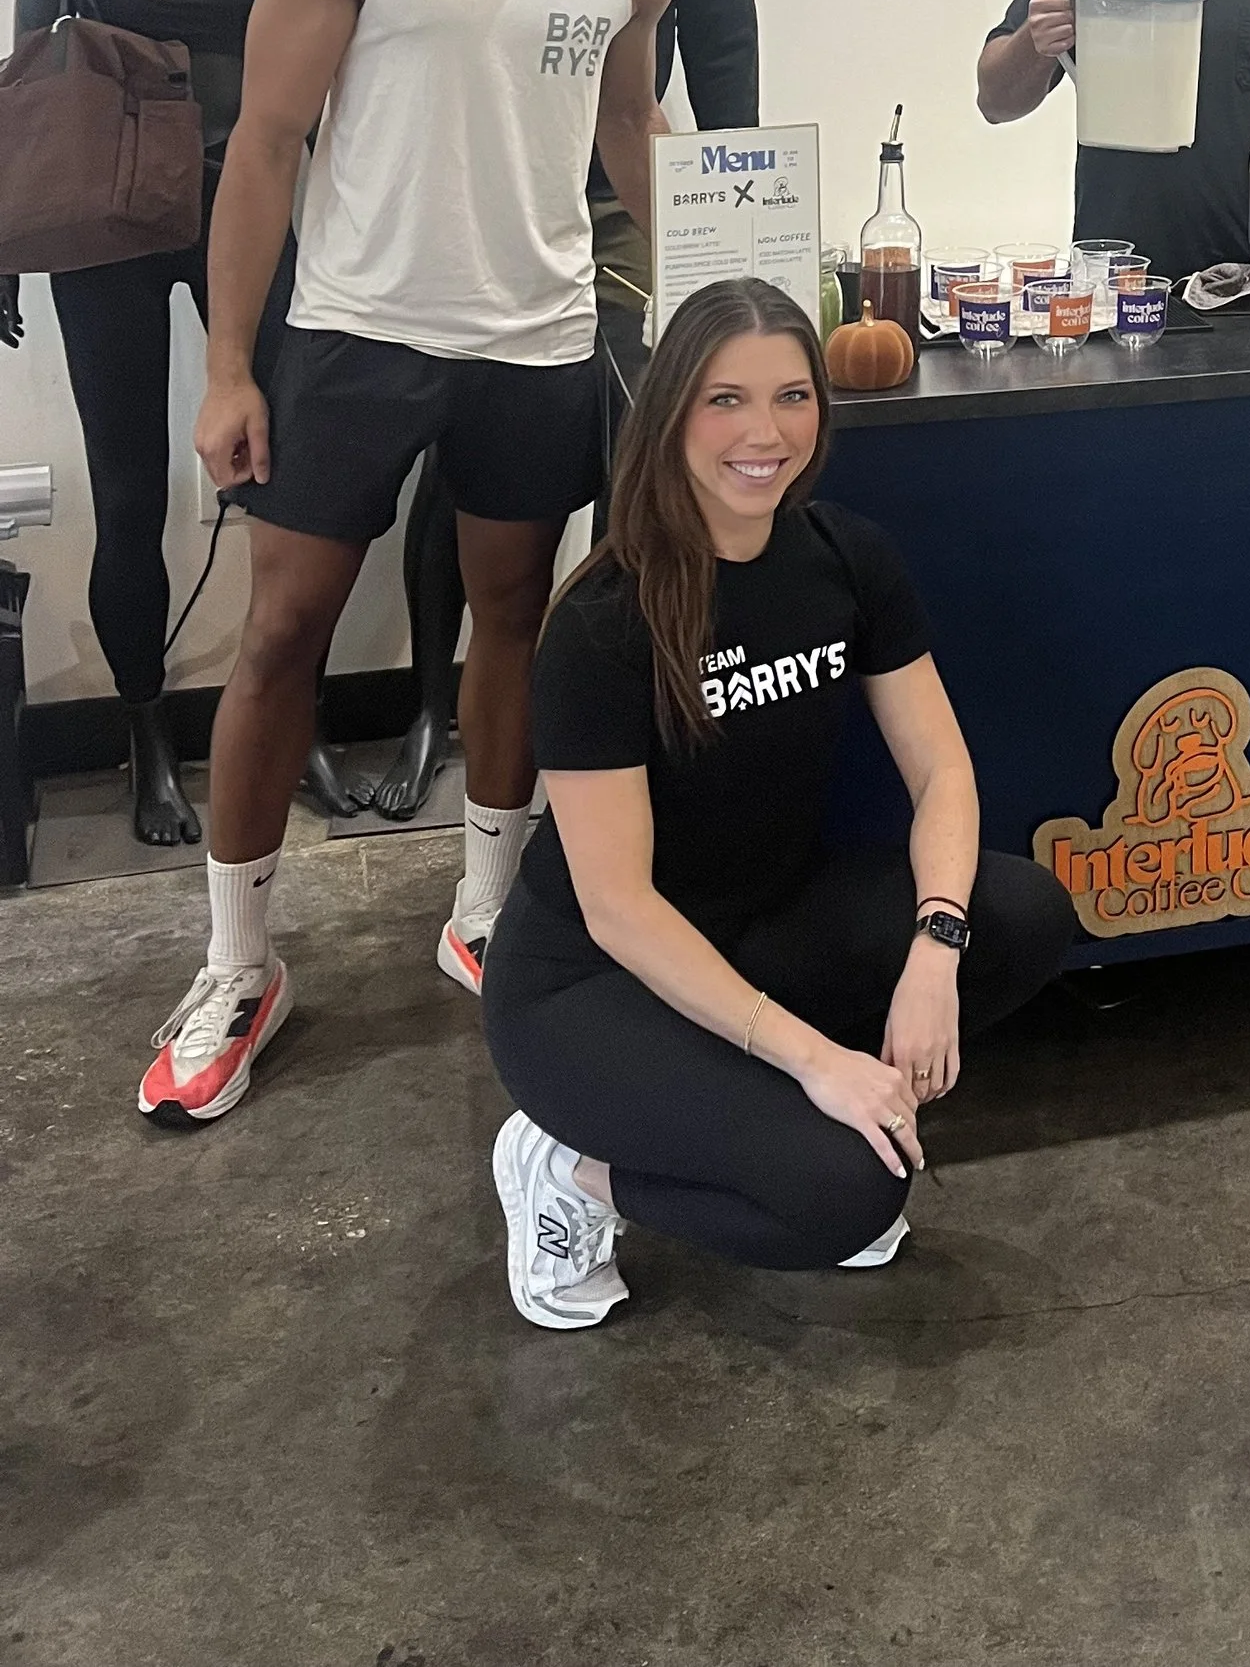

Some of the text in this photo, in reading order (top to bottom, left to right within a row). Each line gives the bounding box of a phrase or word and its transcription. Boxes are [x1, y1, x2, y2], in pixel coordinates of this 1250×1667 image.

[540, 46, 600, 77] RYS
[701, 145, 776, 175] Menu
[666, 226, 717, 238] COLD BREW
[757, 232, 811, 244] NON COFFEE
[962, 307, 1006, 323] interlude
[1122, 300, 1164, 315] interlude
[1127, 313, 1160, 324] coffee
[965, 321, 1000, 332] coffee
[1096, 873, 1226, 921] Coffee
